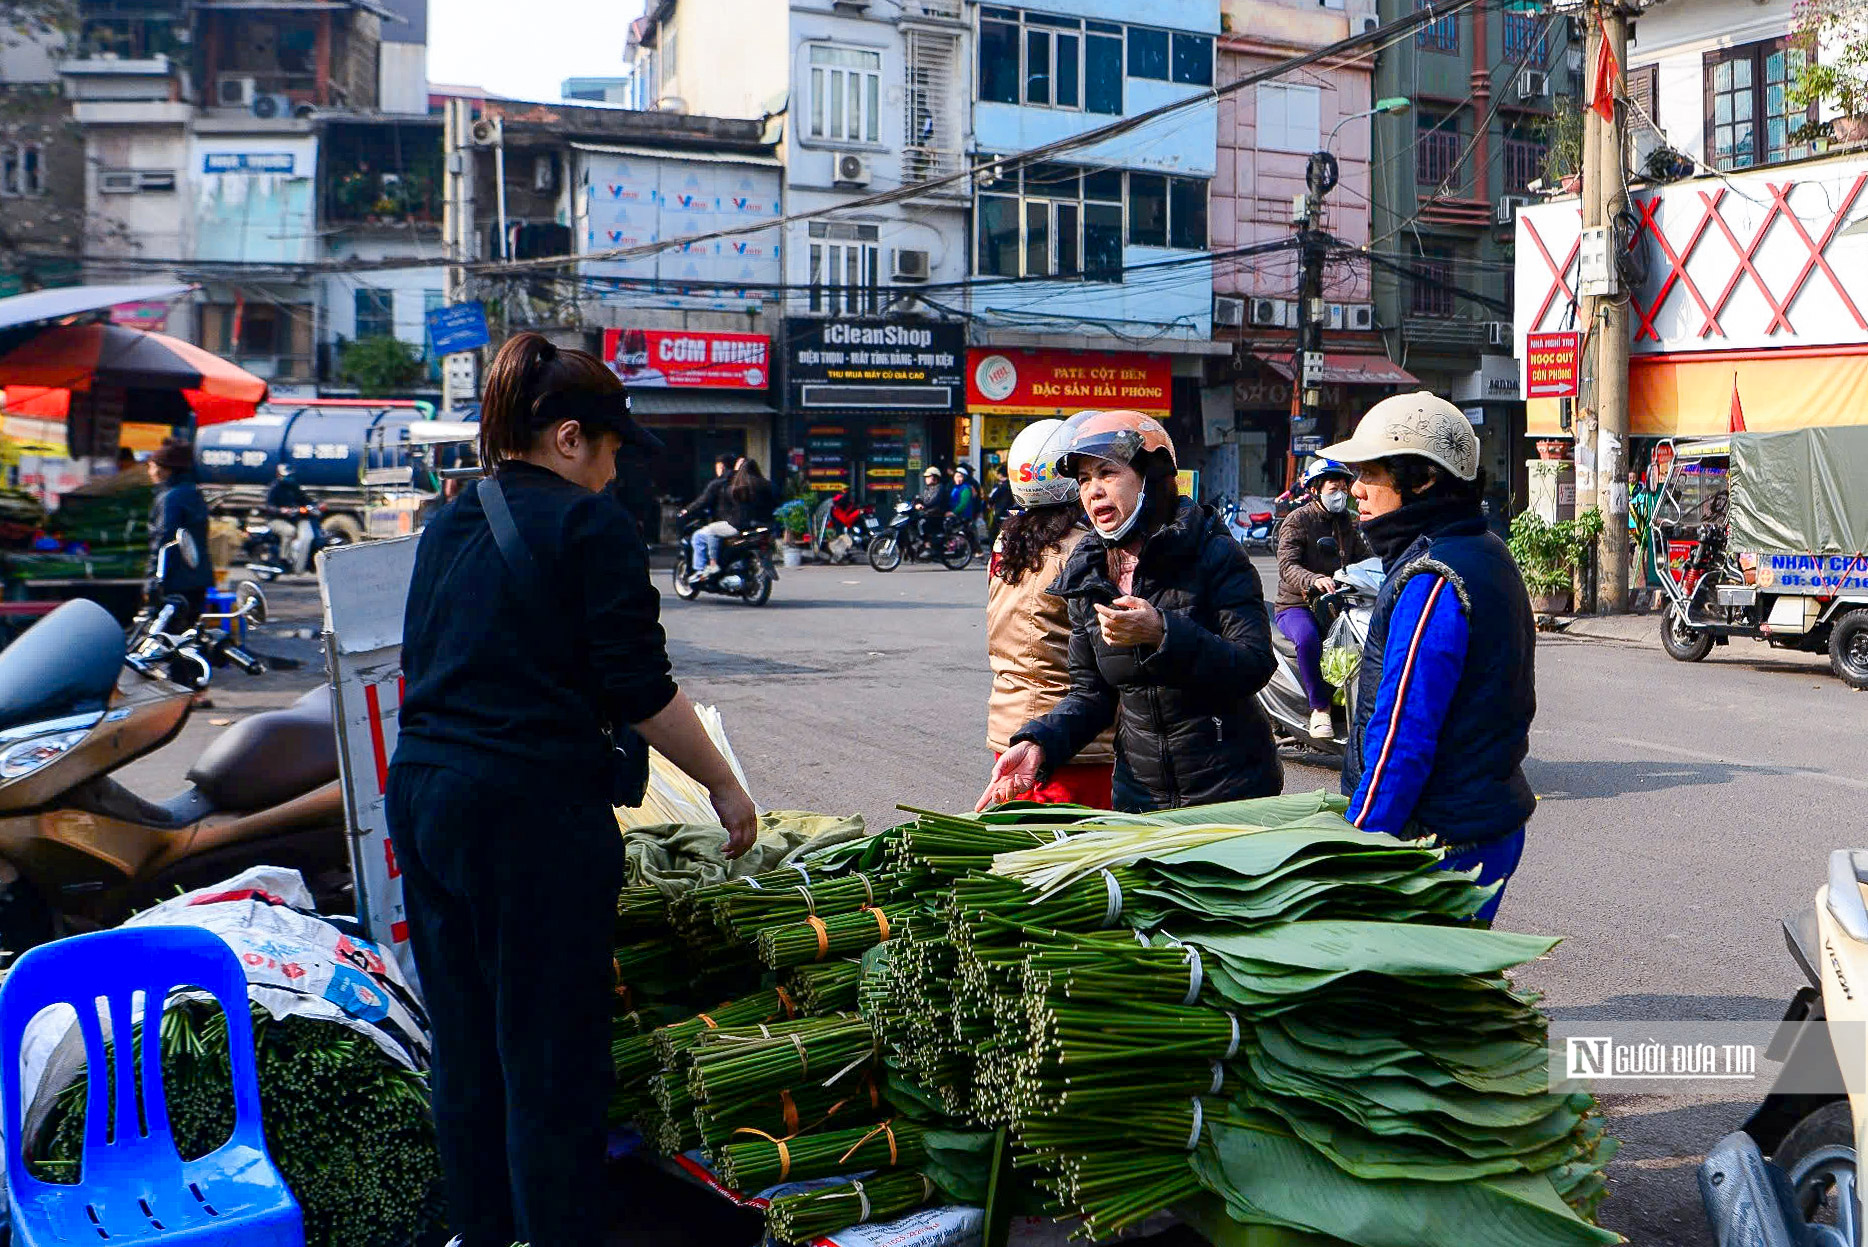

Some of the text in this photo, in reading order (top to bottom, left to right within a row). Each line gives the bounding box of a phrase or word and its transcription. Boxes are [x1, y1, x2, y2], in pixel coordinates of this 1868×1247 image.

[824, 323, 932, 347] iCleanShop
[1531, 338, 1544, 349] NHÀ
[658, 337, 766, 364] CƠM MINH
[1530, 350, 1575, 367] NGỌC QUÝ
[828, 370, 844, 378] THU
[845, 370, 863, 379] MUA
[864, 369, 881, 379] MÁY
[908, 371, 925, 380] CAO
[1053, 367, 1086, 379] PATE
[1090, 367, 1116, 381] CỘT
[1064, 381, 1090, 396] SẢN
[1094, 382, 1117, 397] HẢI
[1121, 384, 1163, 398] PHÒNG
